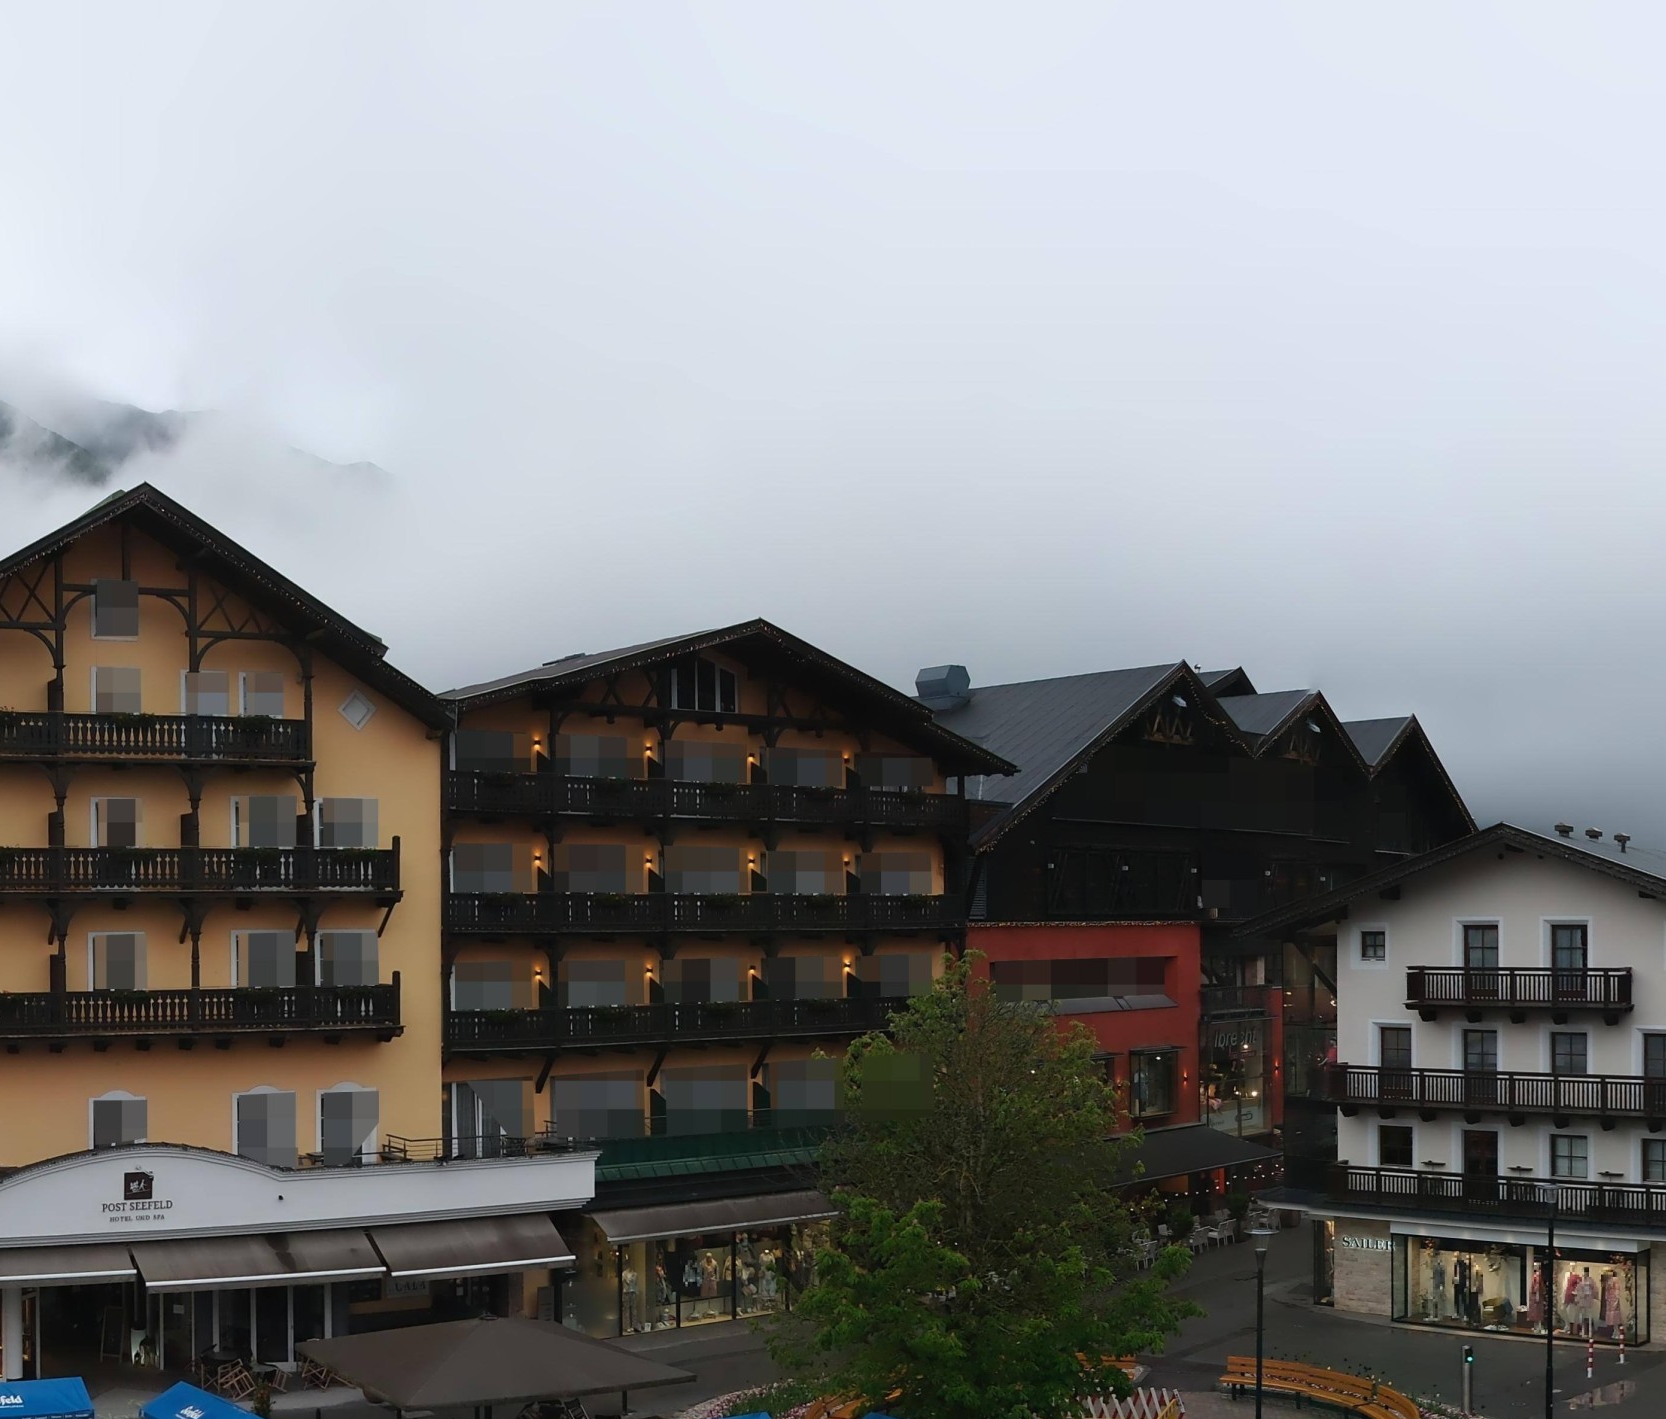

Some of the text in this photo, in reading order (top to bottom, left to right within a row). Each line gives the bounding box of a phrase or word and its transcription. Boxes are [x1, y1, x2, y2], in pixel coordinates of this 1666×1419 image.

[102, 1200, 173, 1213] POST SEEFELD
[1342, 1236, 1395, 1252] SAILER
